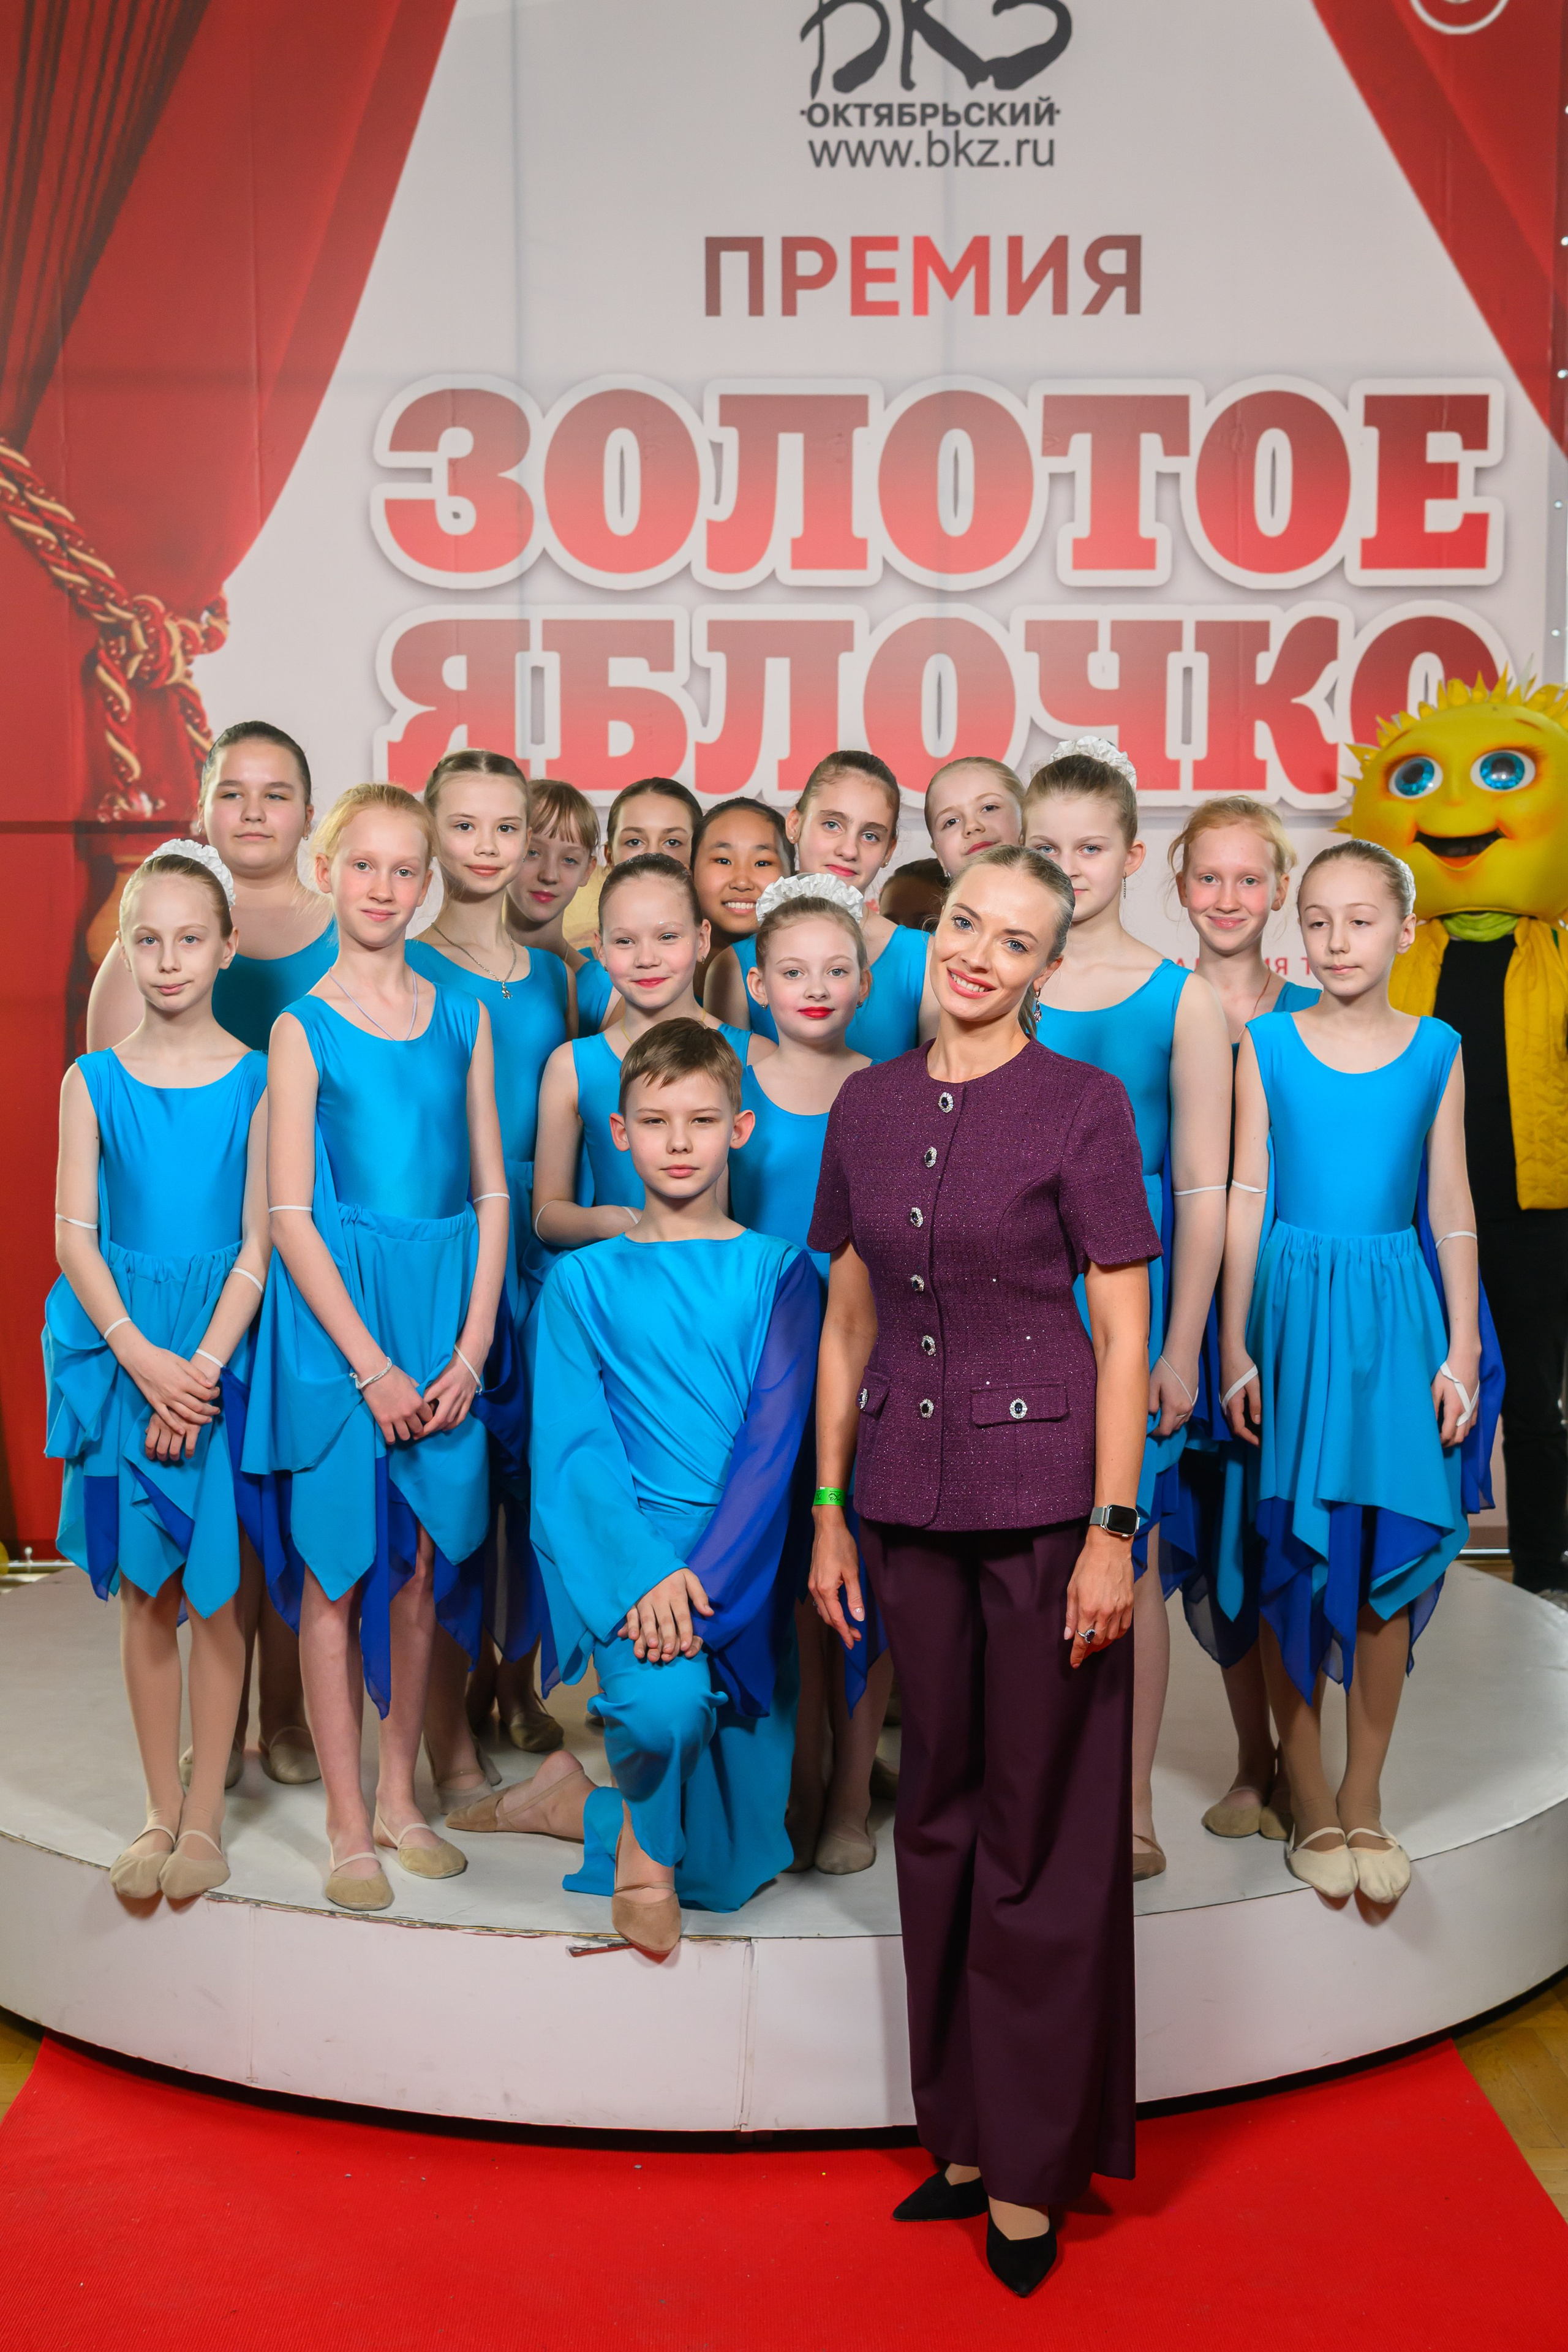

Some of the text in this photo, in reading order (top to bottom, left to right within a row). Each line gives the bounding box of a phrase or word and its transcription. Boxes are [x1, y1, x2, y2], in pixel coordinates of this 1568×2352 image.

[808, 130, 1054, 167] www.bkz.ru
[705, 235, 1142, 316] ПРЕМИЯ
[384, 388, 1490, 574] ЗОЛОТОЕ
